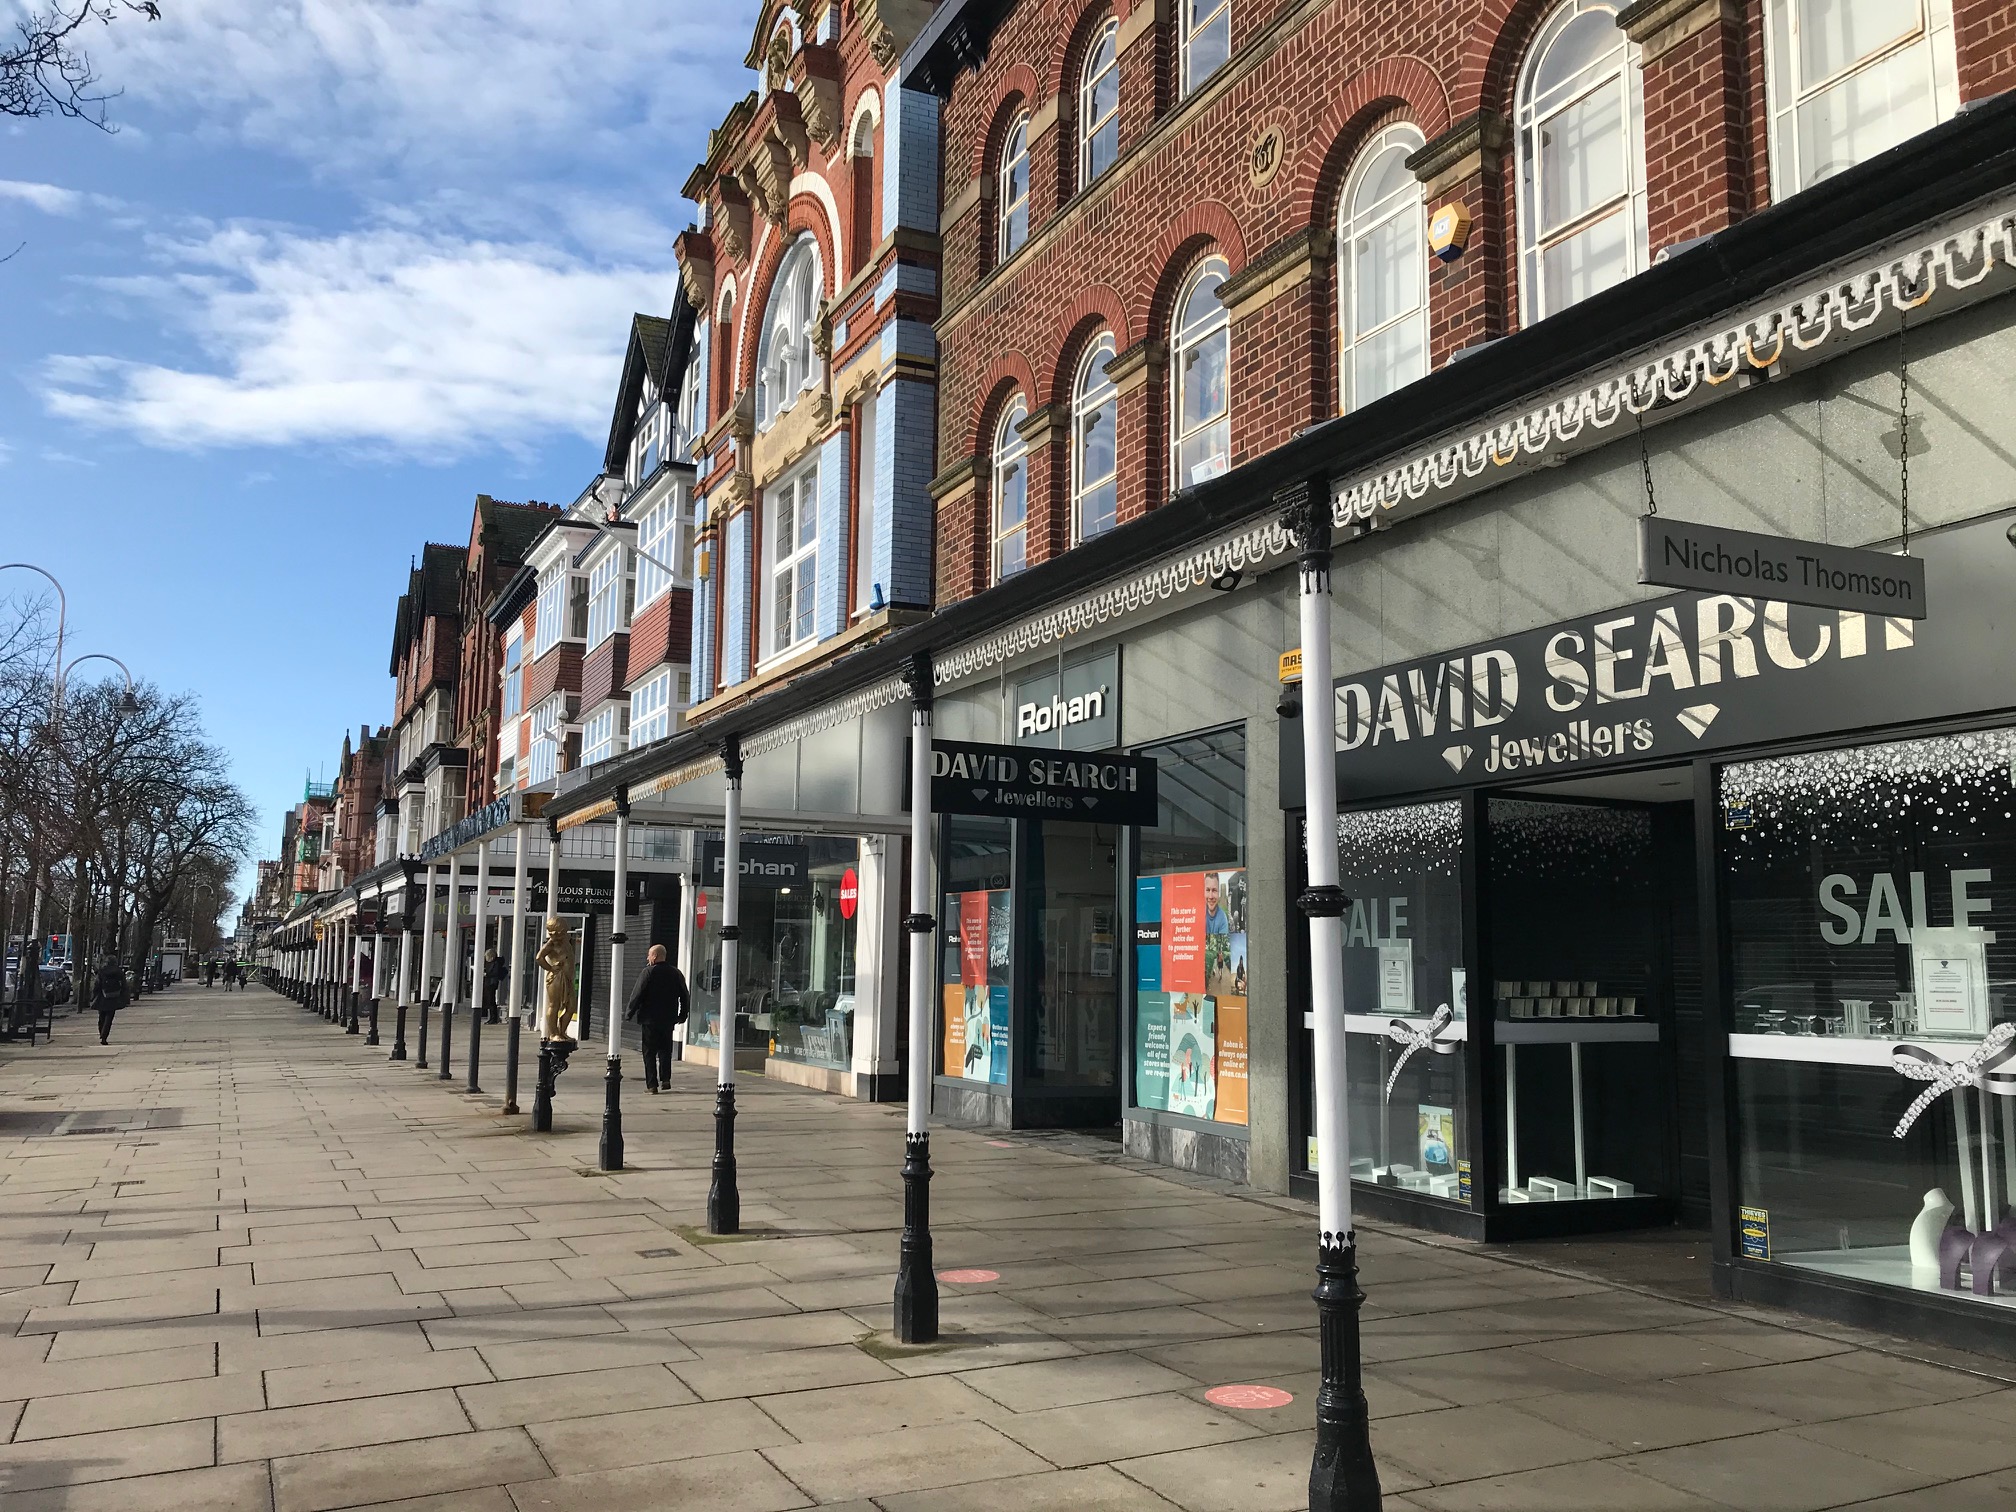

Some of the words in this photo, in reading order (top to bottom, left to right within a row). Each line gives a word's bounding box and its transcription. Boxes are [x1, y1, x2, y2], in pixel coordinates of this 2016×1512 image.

[1434, 219, 1450, 236] ADT
[1664, 535, 1788, 583] Nicholas
[1796, 556, 1912, 600] Thomson
[1334, 649, 1519, 752] DAVID
[1485, 717, 1655, 773] Jewellers
[931, 750, 1018, 783] DAVID
[1028, 759, 1137, 792] SEARCH
[994, 788, 1074, 810] Jewellers
[538, 886, 584, 895] FAULOUS
[586, 888, 635, 897] FURNIRE
[841, 888, 857, 899] SALES
[1819, 868, 1996, 946] SALE
[1137, 930, 1159, 939] Rohan
[1341, 896, 1411, 947] ALE
[1174, 945, 1199, 953] government
